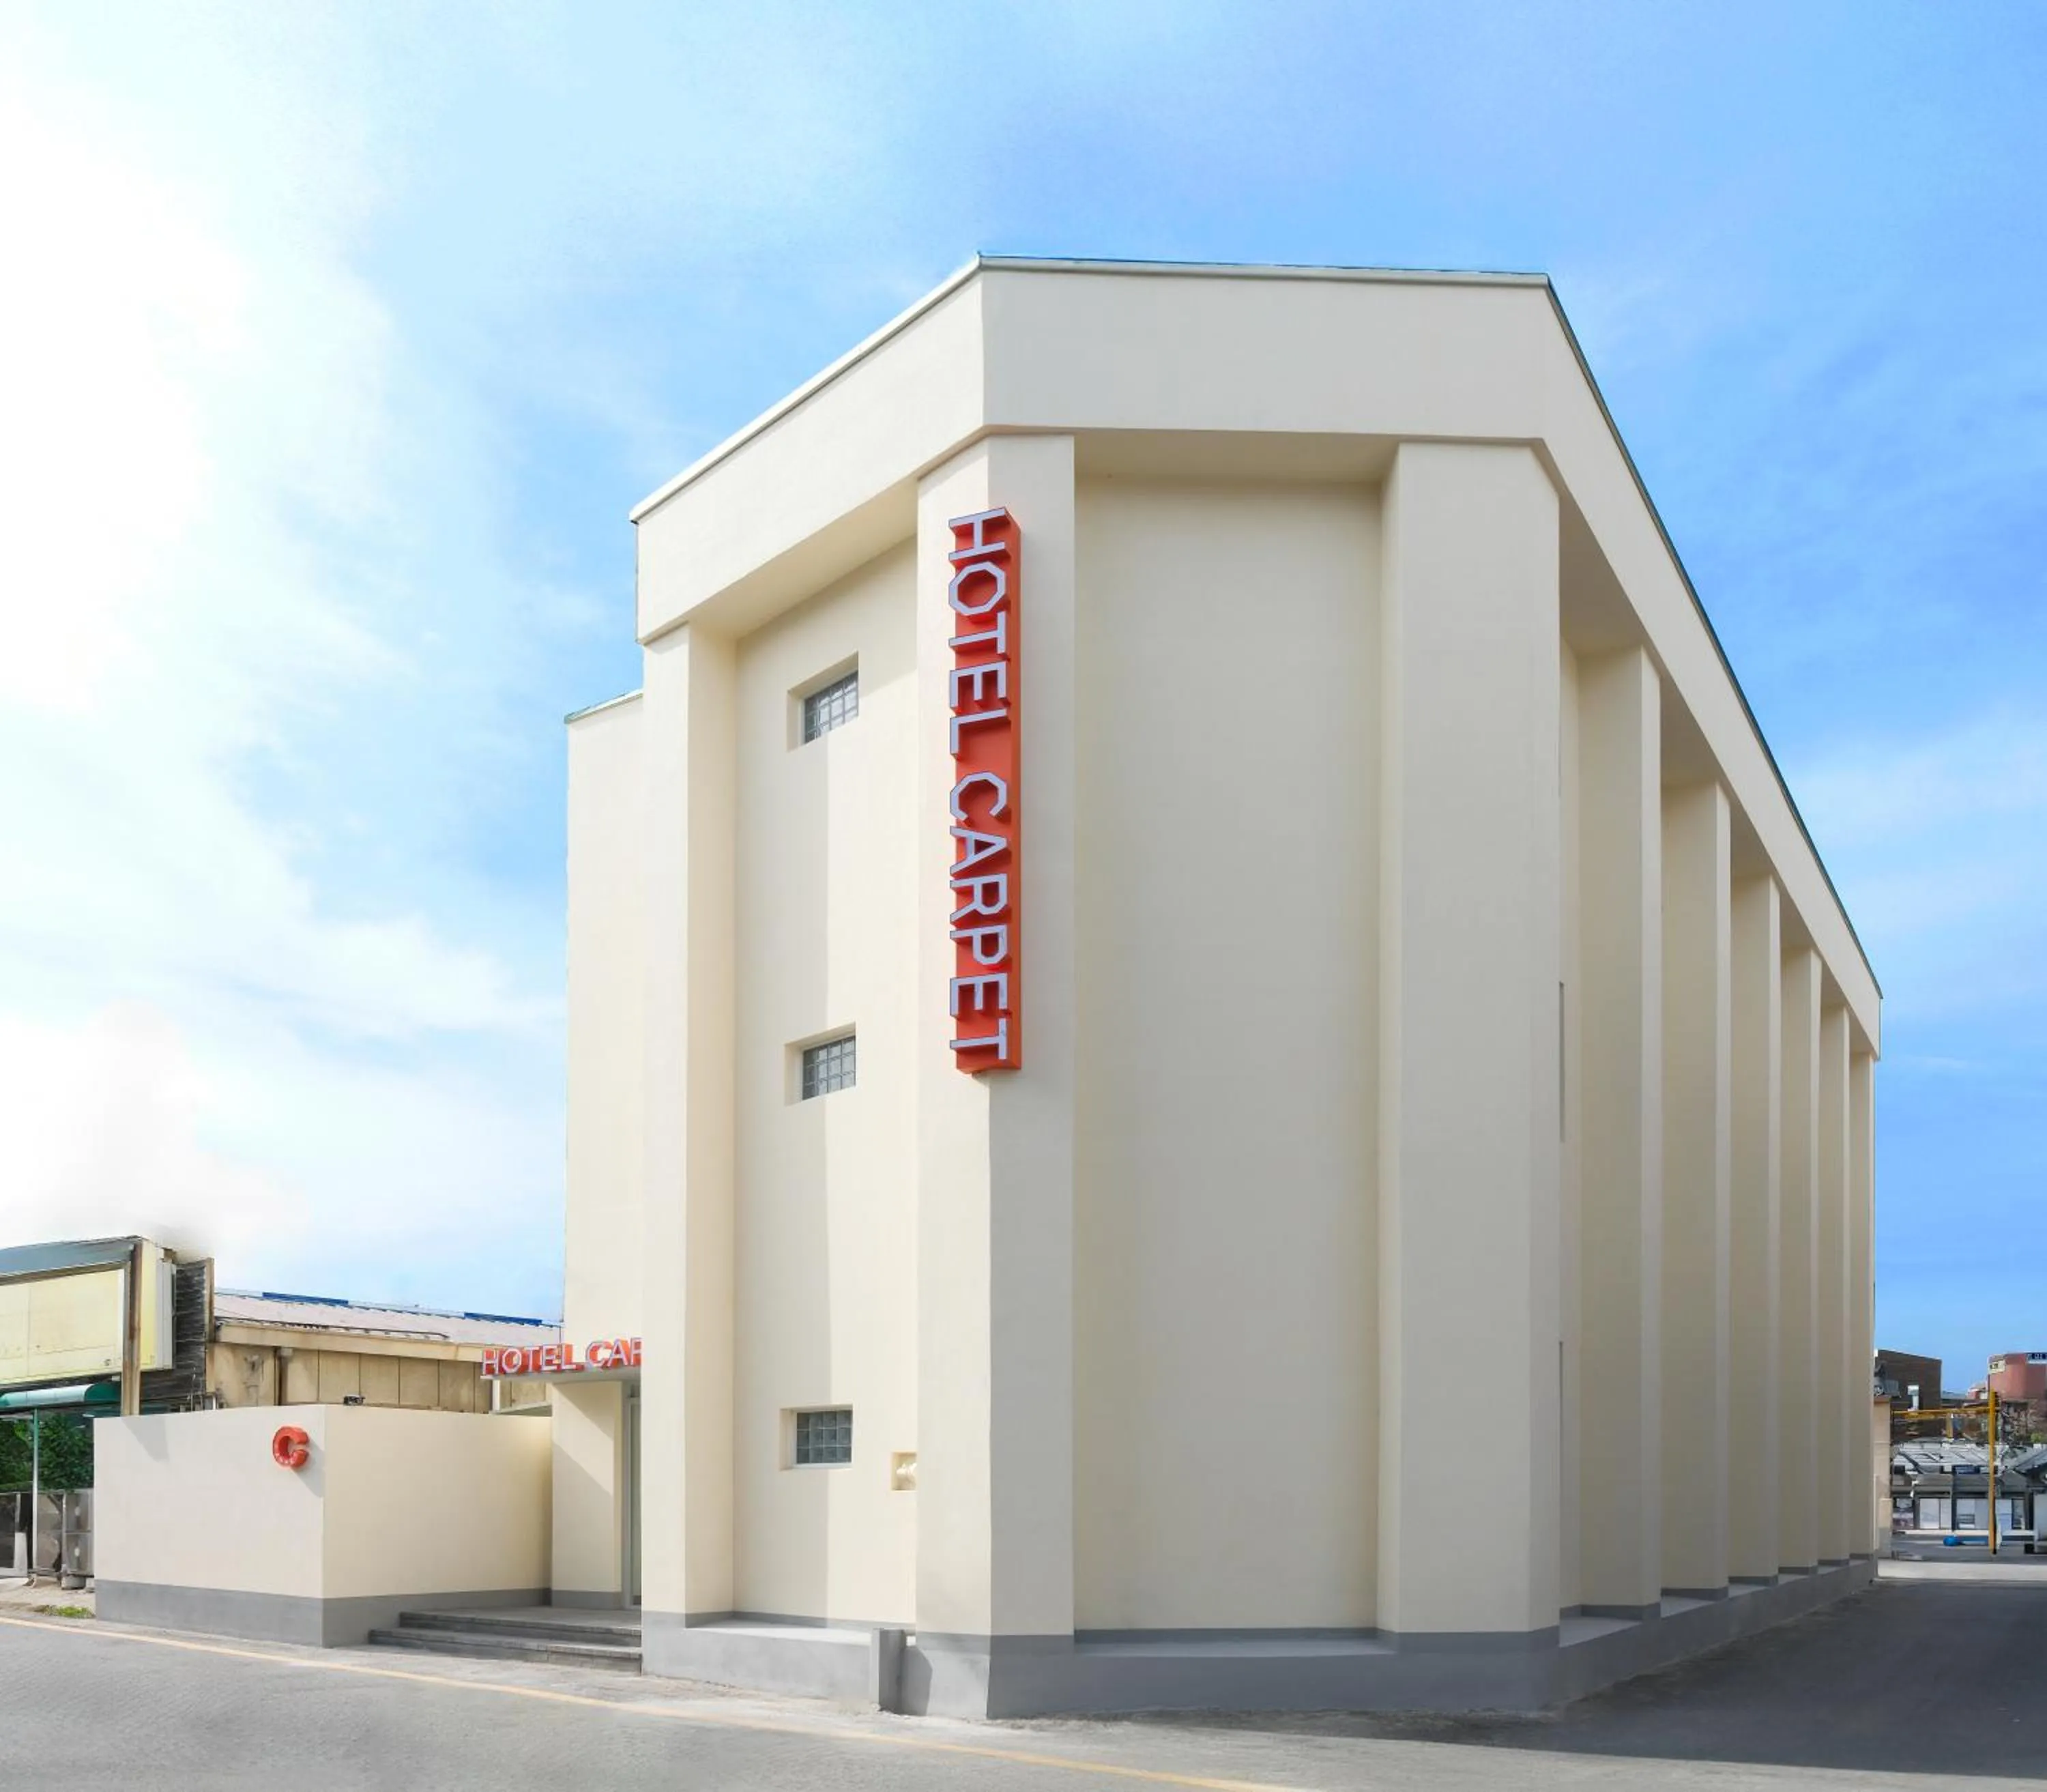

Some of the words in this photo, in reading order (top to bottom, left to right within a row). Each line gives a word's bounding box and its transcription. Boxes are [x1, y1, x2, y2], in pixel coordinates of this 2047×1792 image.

[948, 507, 1006, 754] HOTEL
[950, 772, 1007, 1060] CARPET
[482, 1343, 577, 1375] HOTEL
